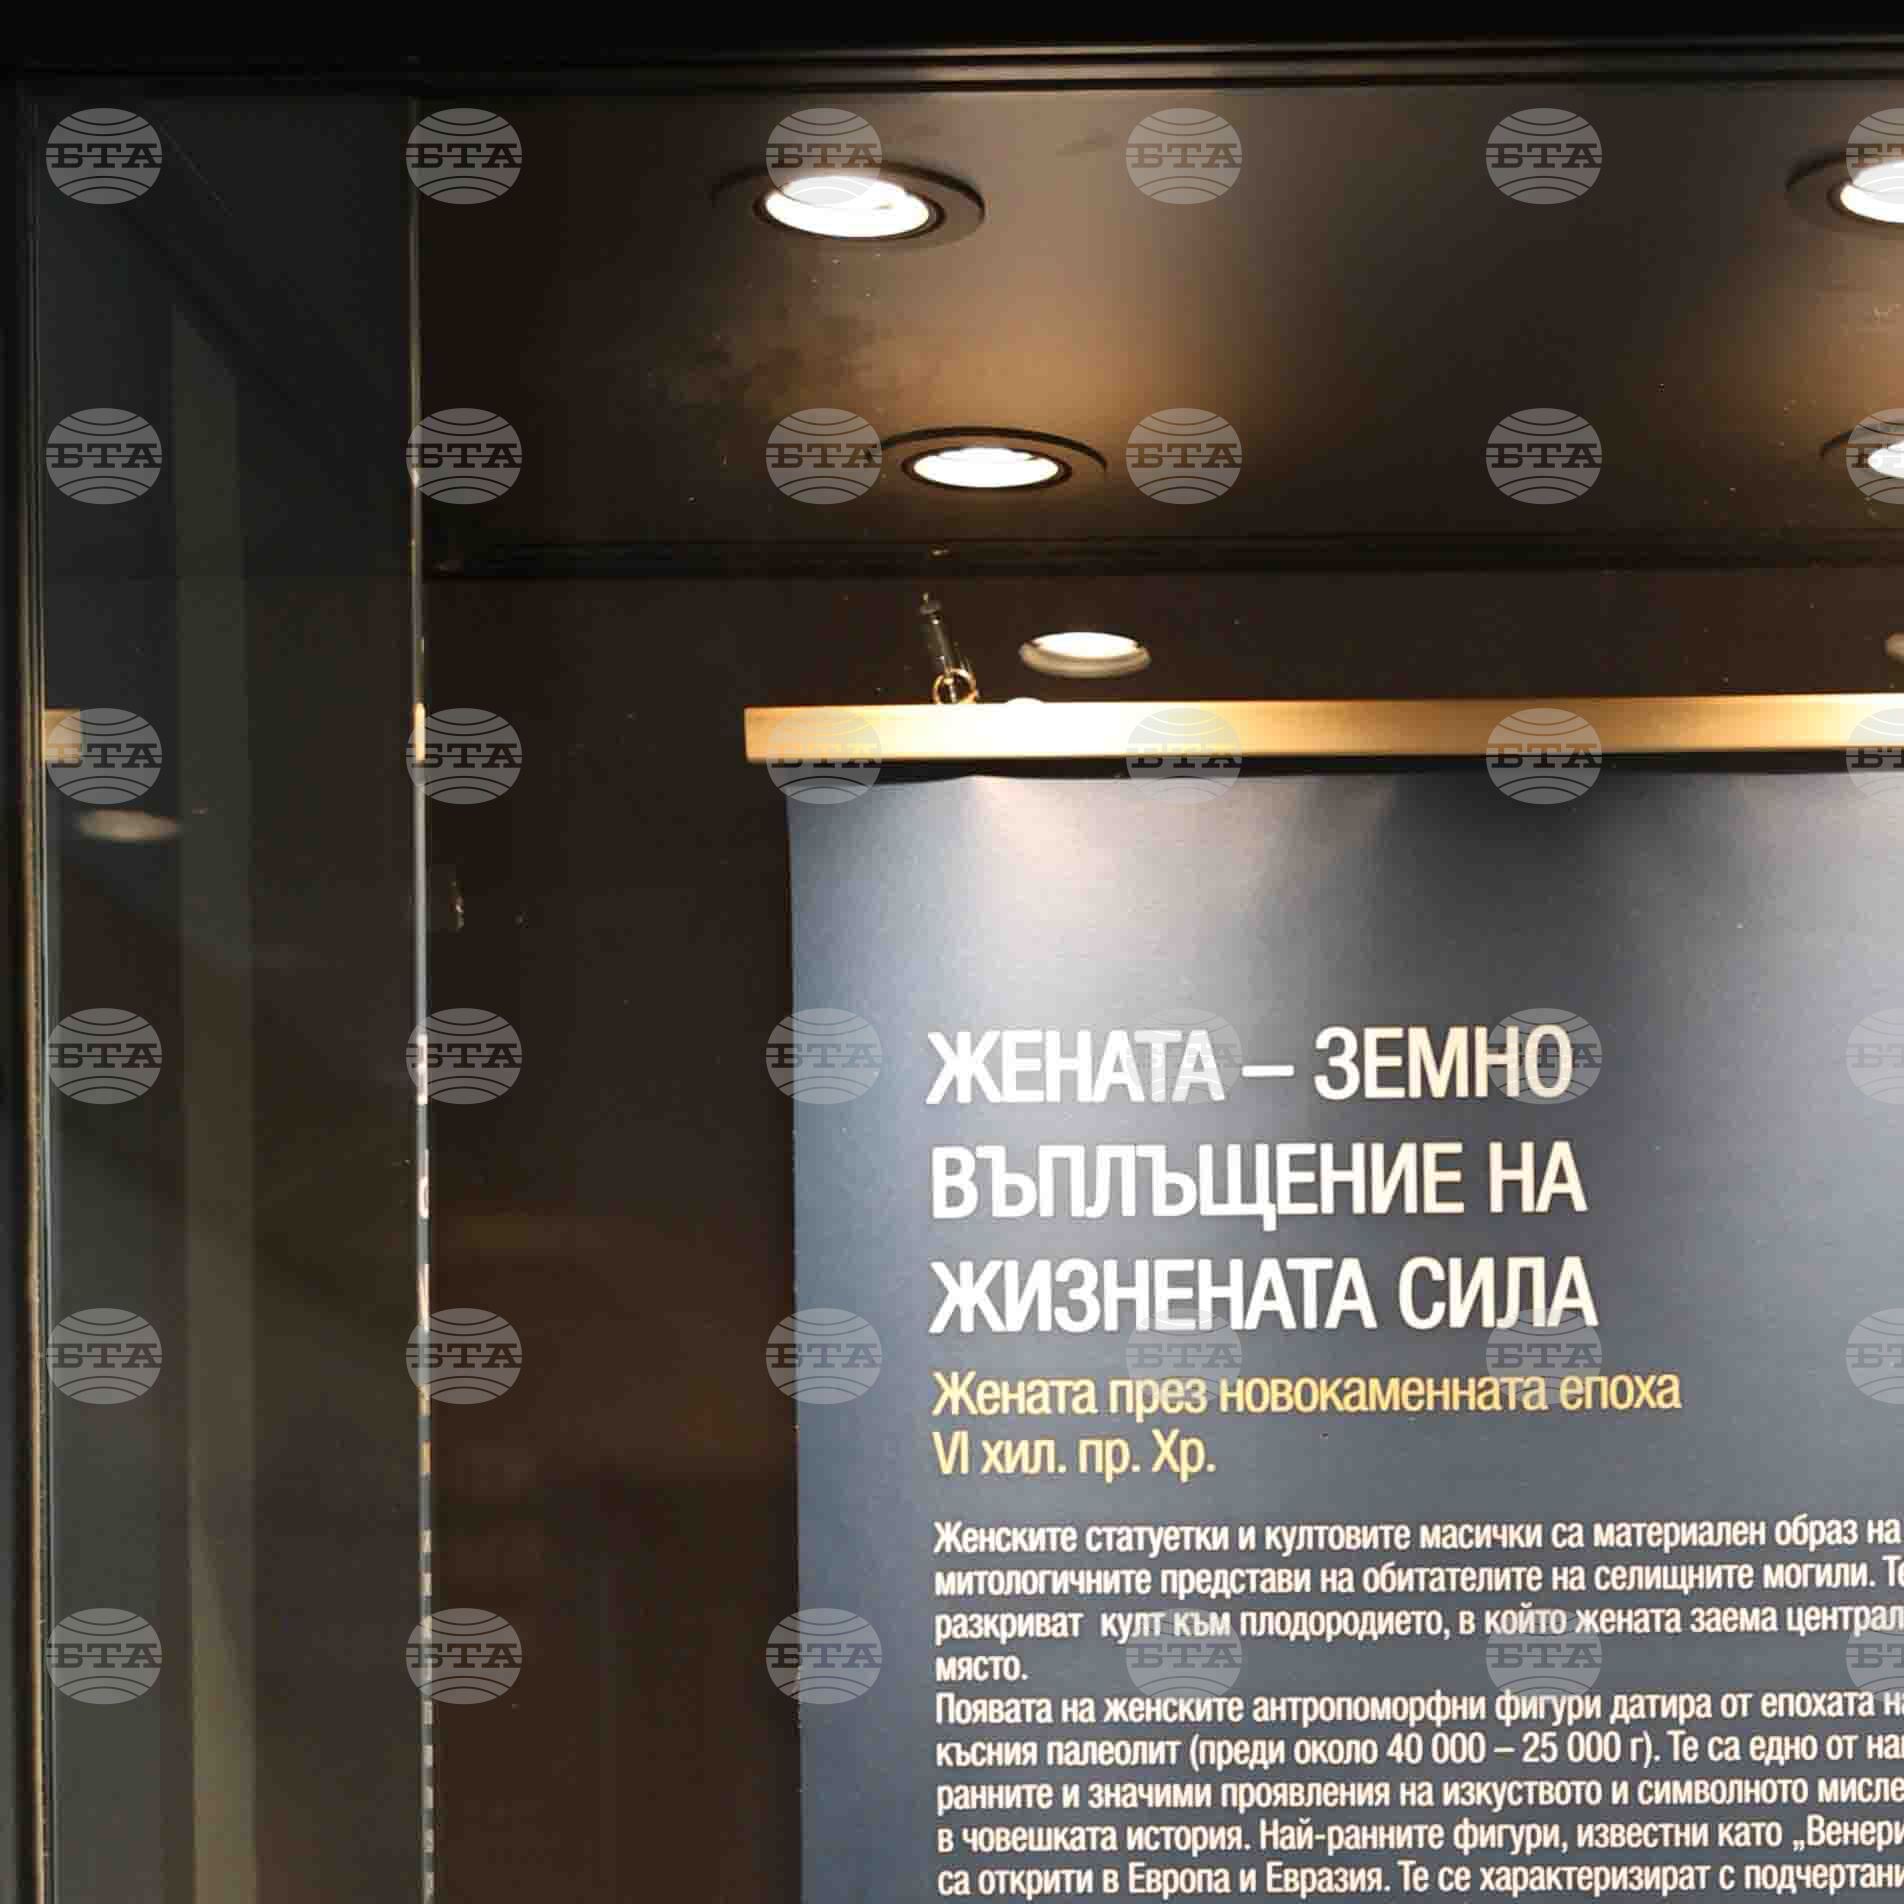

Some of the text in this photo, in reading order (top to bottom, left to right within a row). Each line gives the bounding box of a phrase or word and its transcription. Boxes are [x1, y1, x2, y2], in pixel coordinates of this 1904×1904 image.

[926, 1029, 1226, 1107] ЖЕНАТА
[1314, 1024, 1574, 1101] ЗЕМНО
[932, 1140, 1589, 1232] ВЪПЛЪЩЕНИЕ НА
[928, 1255, 1599, 1334] ЖИЗНЕНАТА СИЛА
[931, 1370, 1683, 1424] Жената през новокаменната епоха
[931, 1427, 1217, 1484] VI хил. пр. Хр.
[933, 1513, 1902, 1559] Женските статуетки и култовите масички са материален образ на
[937, 1828, 955, 1853] в
[961, 1825, 1119, 1853] човешката
[1126, 1825, 1252, 1858] история.
[1259, 1816, 1445, 1857] Най-ранните
[1453, 1816, 1569, 1856] фигури,
[1576, 1821, 1709, 1849] известни
[1717, 1821, 1783, 1848] като
